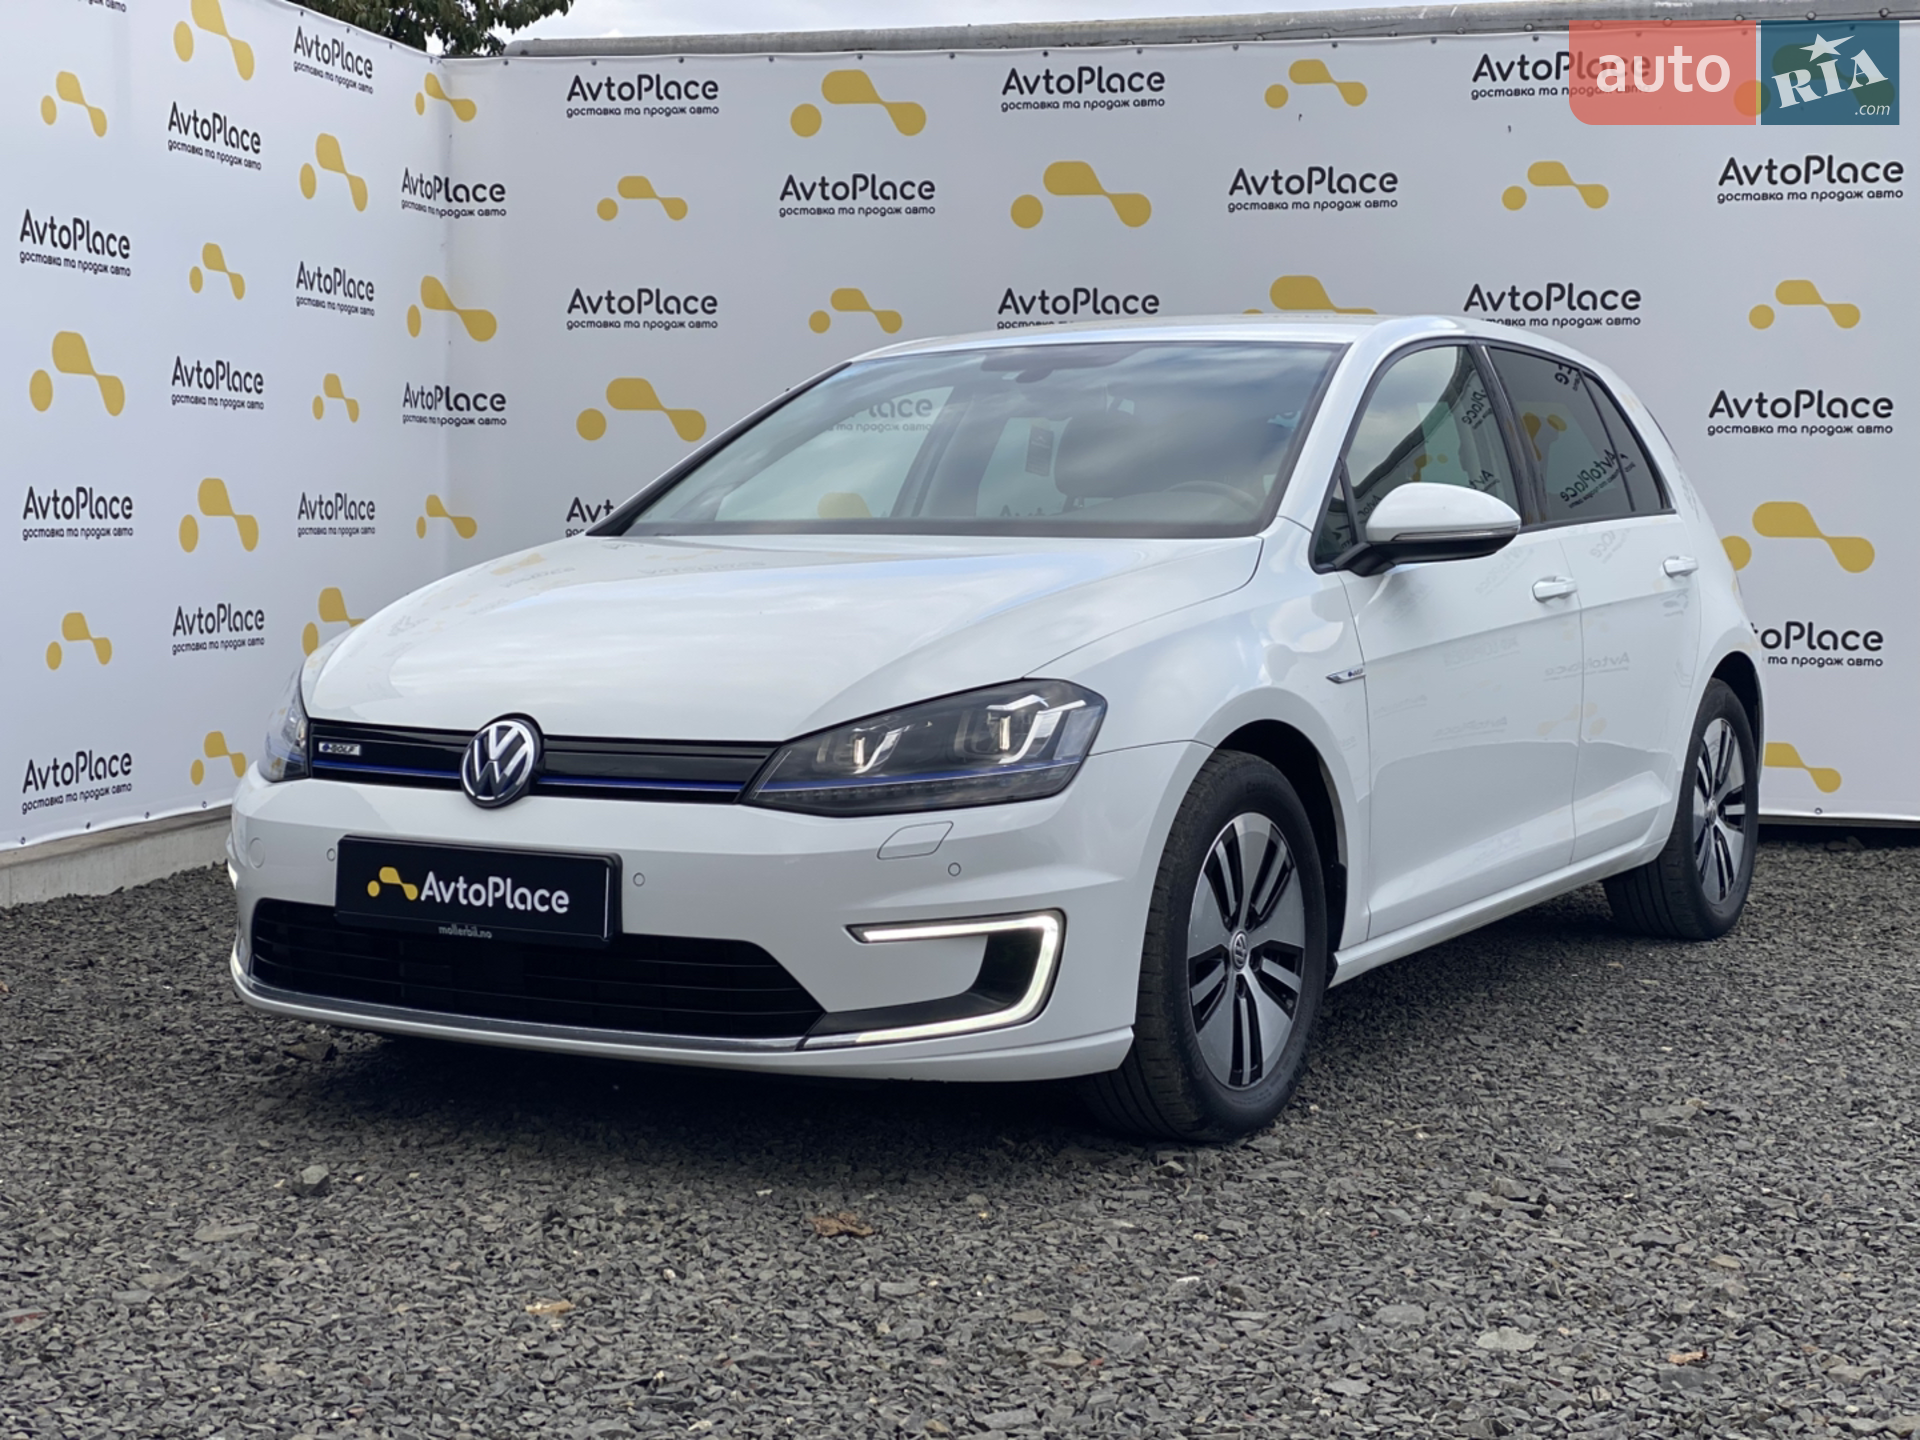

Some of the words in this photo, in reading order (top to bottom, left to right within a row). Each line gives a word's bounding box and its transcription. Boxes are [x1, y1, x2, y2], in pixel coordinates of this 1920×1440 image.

[294, 26, 374, 80] AvtoPlace
[566, 74, 720, 102] AvtoPlace
[1001, 66, 1166, 97] AvtoPlace
[1471, 87, 1535, 100] доставка
[1538, 86, 1558, 97] та
[1562, 86, 1612, 98] прода
[566, 107, 621, 118] доставка
[624, 107, 640, 116] та
[644, 106, 686, 117] продаж
[689, 106, 719, 115] авто
[1001, 101, 1060, 112] доставка
[1063, 101, 1080, 109] та
[1084, 100, 1130, 111] продаж
[1133, 98, 1165, 108] авто
[168, 101, 262, 155] AvtoPlace
[402, 167, 507, 204] AvtoPlace
[1228, 166, 1399, 197] AvtoPlace
[1717, 154, 1905, 187] AvtoPlace
[779, 174, 936, 202] AvtoPlace
[1717, 191, 1784, 204] доставка
[1787, 191, 1807, 201] та
[1811, 190, 1863, 203] продаж
[1867, 189, 1904, 199] авто
[779, 207, 835, 218] доставка
[838, 207, 855, 215] та
[858, 206, 902, 218] продаж
[905, 206, 936, 215] авто
[1228, 201, 1288, 214] доставка
[1292, 201, 1310, 210] та
[1313, 200, 1361, 212] продаж
[1364, 199, 1398, 209] авто
[20, 208, 131, 260] AvtoPlace
[296, 261, 375, 302] AvtoPlace
[566, 288, 719, 315] AvtoPlace
[997, 287, 1161, 315] AvtoPlace
[1463, 282, 1642, 313] AvtoPlace
[566, 320, 621, 331] доставка
[624, 320, 640, 328] та
[643, 320, 686, 332] продаж
[688, 320, 718, 329] авто
[1529, 318, 1549, 327] та
[1552, 317, 1602, 329] продаж
[1606, 316, 1641, 326] авто
[172, 356, 265, 395] AvtoPlace
[402, 382, 507, 413] AvtoPlace
[1708, 389, 1894, 419] AvtoPlace
[1708, 424, 1774, 437] доставка
[1777, 424, 1797, 434] та
[1801, 424, 1853, 437] продаж
[1856, 424, 1894, 435] авто
[22, 486, 134, 521] AvtoPlace
[297, 492, 376, 521] AvtoPlace
[22, 527, 64, 541] доставка
[80, 527, 111, 541] продаж
[112, 527, 133, 537] авто
[172, 603, 265, 637] AvtoPlace
[1751, 621, 1884, 652] oPlace
[1791, 656, 1844, 669] продаж
[1847, 657, 1884, 668] авто
[22, 750, 133, 795] AvtoPlace
[420, 870, 570, 914] AvtoPlace
